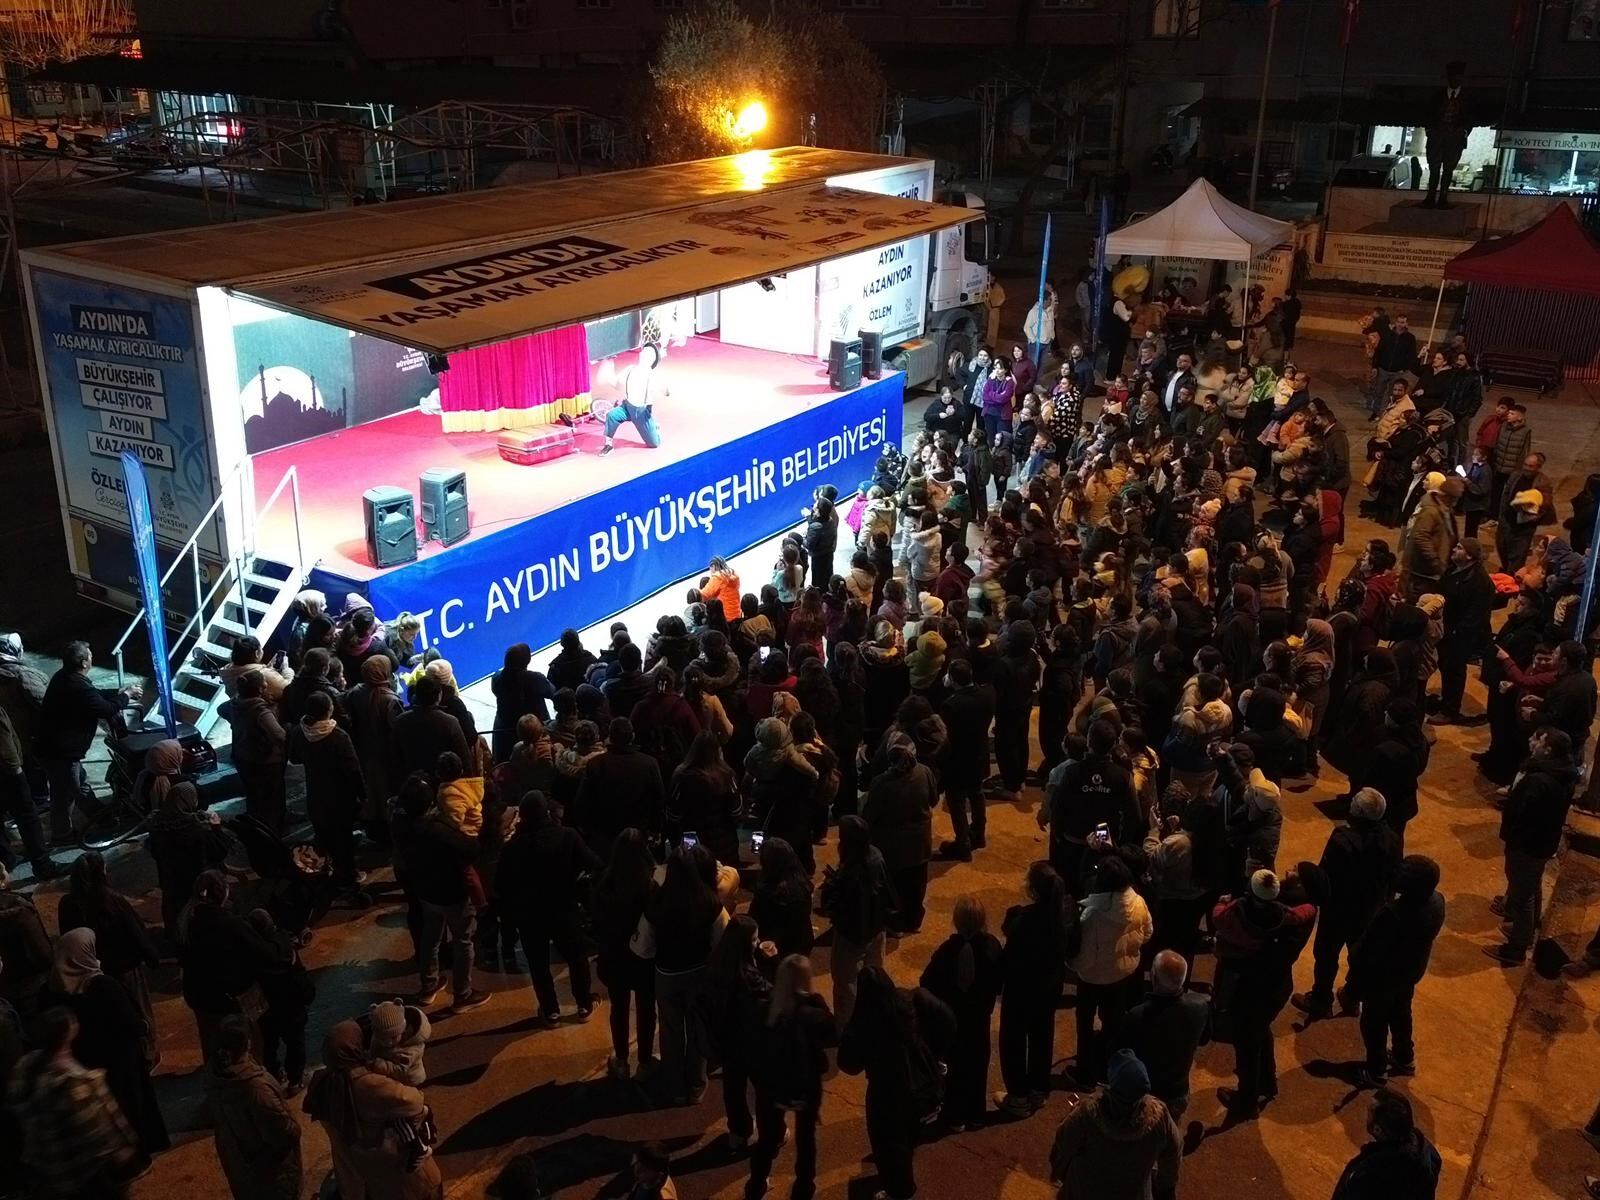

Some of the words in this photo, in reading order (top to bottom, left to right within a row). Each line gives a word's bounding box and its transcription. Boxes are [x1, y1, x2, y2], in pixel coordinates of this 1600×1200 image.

[878, 244, 904, 266] AYDIN
[409, 242, 607, 296] AYDIN'DA
[862, 265, 912, 298] KAZANIYOR
[363, 282, 543, 327] YAŞAMAK
[537, 238, 708, 288] AYRICALIKTIR
[79, 311, 149, 336] AYDIN'DA
[869, 304, 892, 321] ÖZLEM
[53, 333, 106, 352] YAŞAMAK
[107, 338, 184, 361] AYRICALIKTIR
[83, 362, 156, 388] BÜYÜKŞEHİR
[93, 388, 153, 410] ÇALIŞIYOR
[109, 415, 145, 436] AYDIN
[413, 598, 475, 651] T.C.
[485, 547, 581, 623] AYDIN
[589, 458, 776, 573] BÜYÜKŞEHİR
[781, 408, 887, 488] BELEDİYESİ
